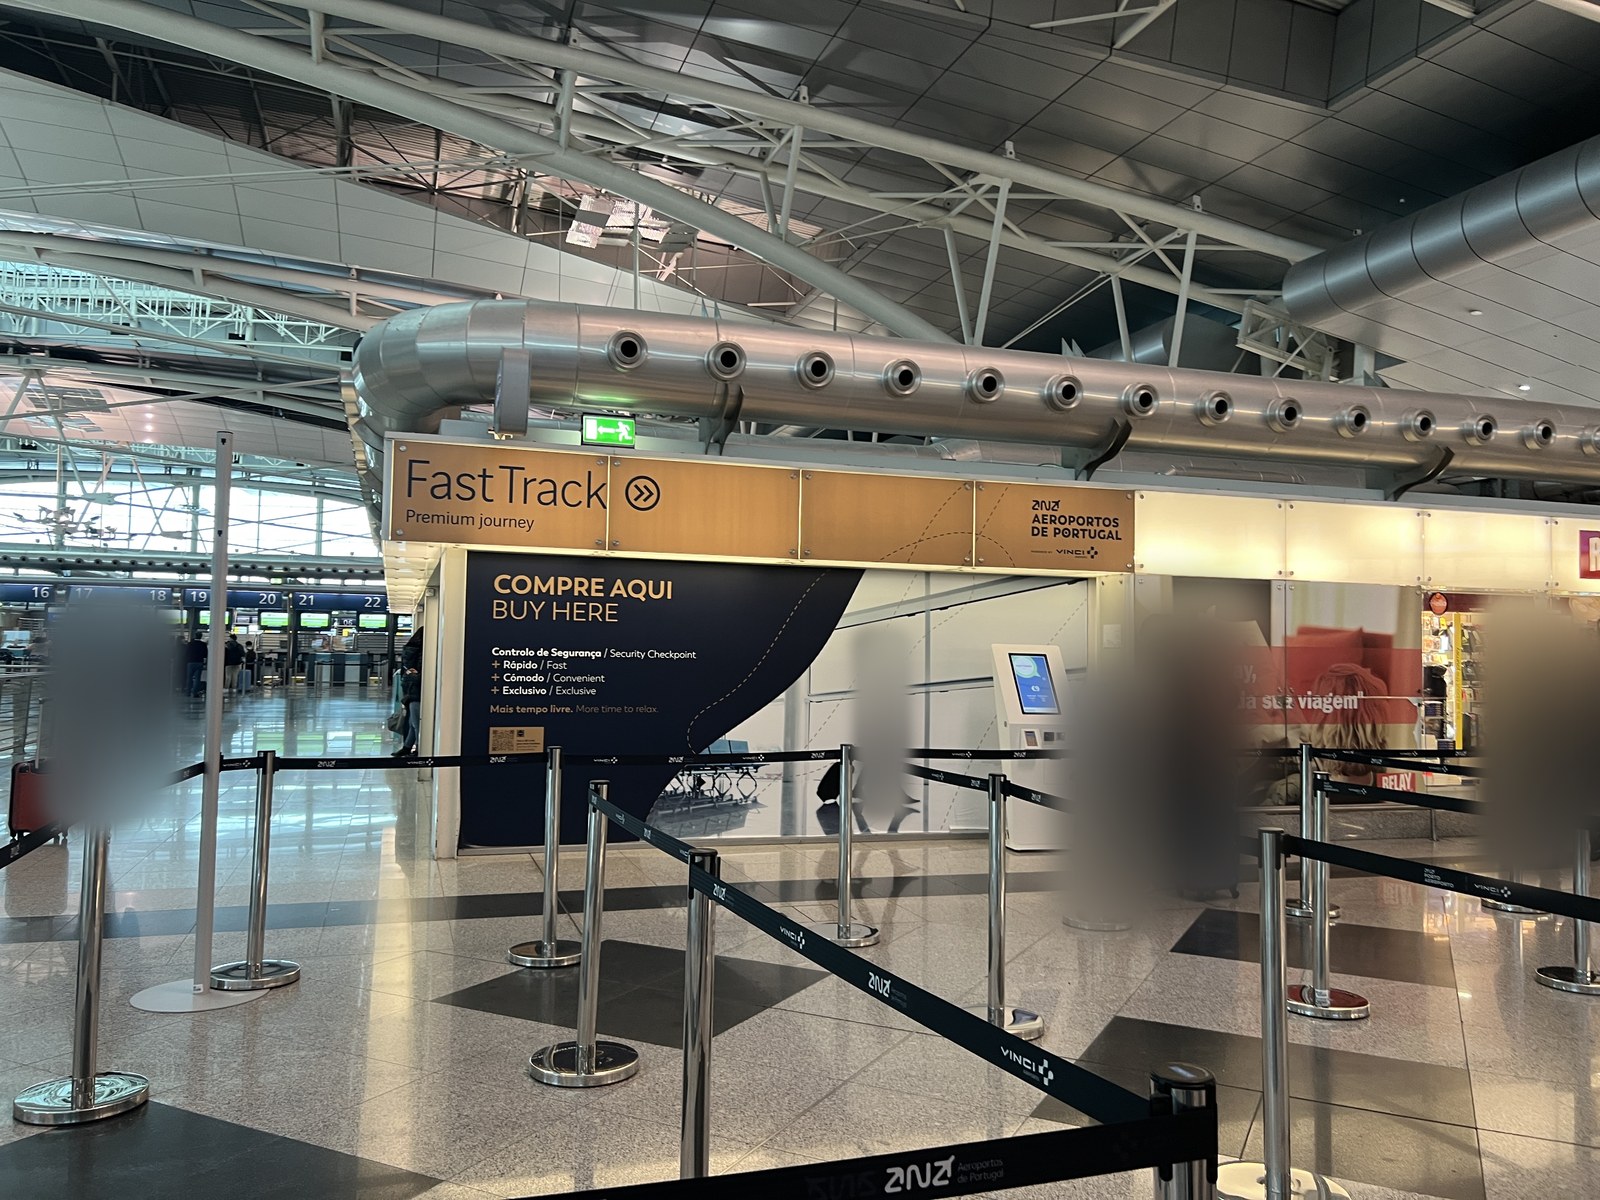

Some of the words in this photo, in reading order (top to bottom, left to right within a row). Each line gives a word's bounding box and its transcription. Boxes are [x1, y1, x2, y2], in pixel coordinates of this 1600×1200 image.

[407, 459, 494, 502] Fast
[498, 465, 607, 509] Track
[405, 509, 475, 526] Premium
[478, 513, 535, 532] journey
[1032, 513, 1119, 528] AEROPORTOS
[1031, 526, 1048, 537] DE
[1053, 527, 1122, 540] PORTUGAL
[31, 586, 50, 599] 16
[75, 587, 93, 599] 17
[493, 574, 605, 597] COMPRE
[609, 578, 673, 601] AQUI
[149, 590, 167, 602] 18
[190, 591, 207, 603] 19
[258, 593, 276, 605] 20
[299, 594, 314, 606] 21
[364, 596, 381, 608] 22
[492, 599, 545, 621] BUY
[552, 601, 619, 622] HERE
[492, 647, 535, 657] Controlo
[536, 648, 549, 657] de
[551, 648, 602, 659] Segurança
[610, 649, 646, 660] Security
[647, 650, 697, 660] Checkpoint
[503, 660, 538, 671] Rápido
[546, 661, 568, 670] Fast
[503, 673, 545, 682] Cómodo
[552, 673, 606, 683] Convenient
[502, 686, 547, 695] Exclusivo
[555, 686, 597, 695] Exclusive
[490, 705, 514, 713] Mais
[515, 705, 549, 714] tempo
[550, 705, 574, 713] livre.
[575, 705, 600, 713] More
[601, 705, 622, 713] time
[635, 705, 659, 713] relax.
[1381, 773, 1412, 791] RELAY
[780, 926, 797, 941] VINCI
[1001, 1046, 1035, 1072] VINCI
[957, 1158, 1004, 1173] Aeroportos
[957, 1174, 968, 1184] de
[969, 1169, 1004, 1182] Portugal
